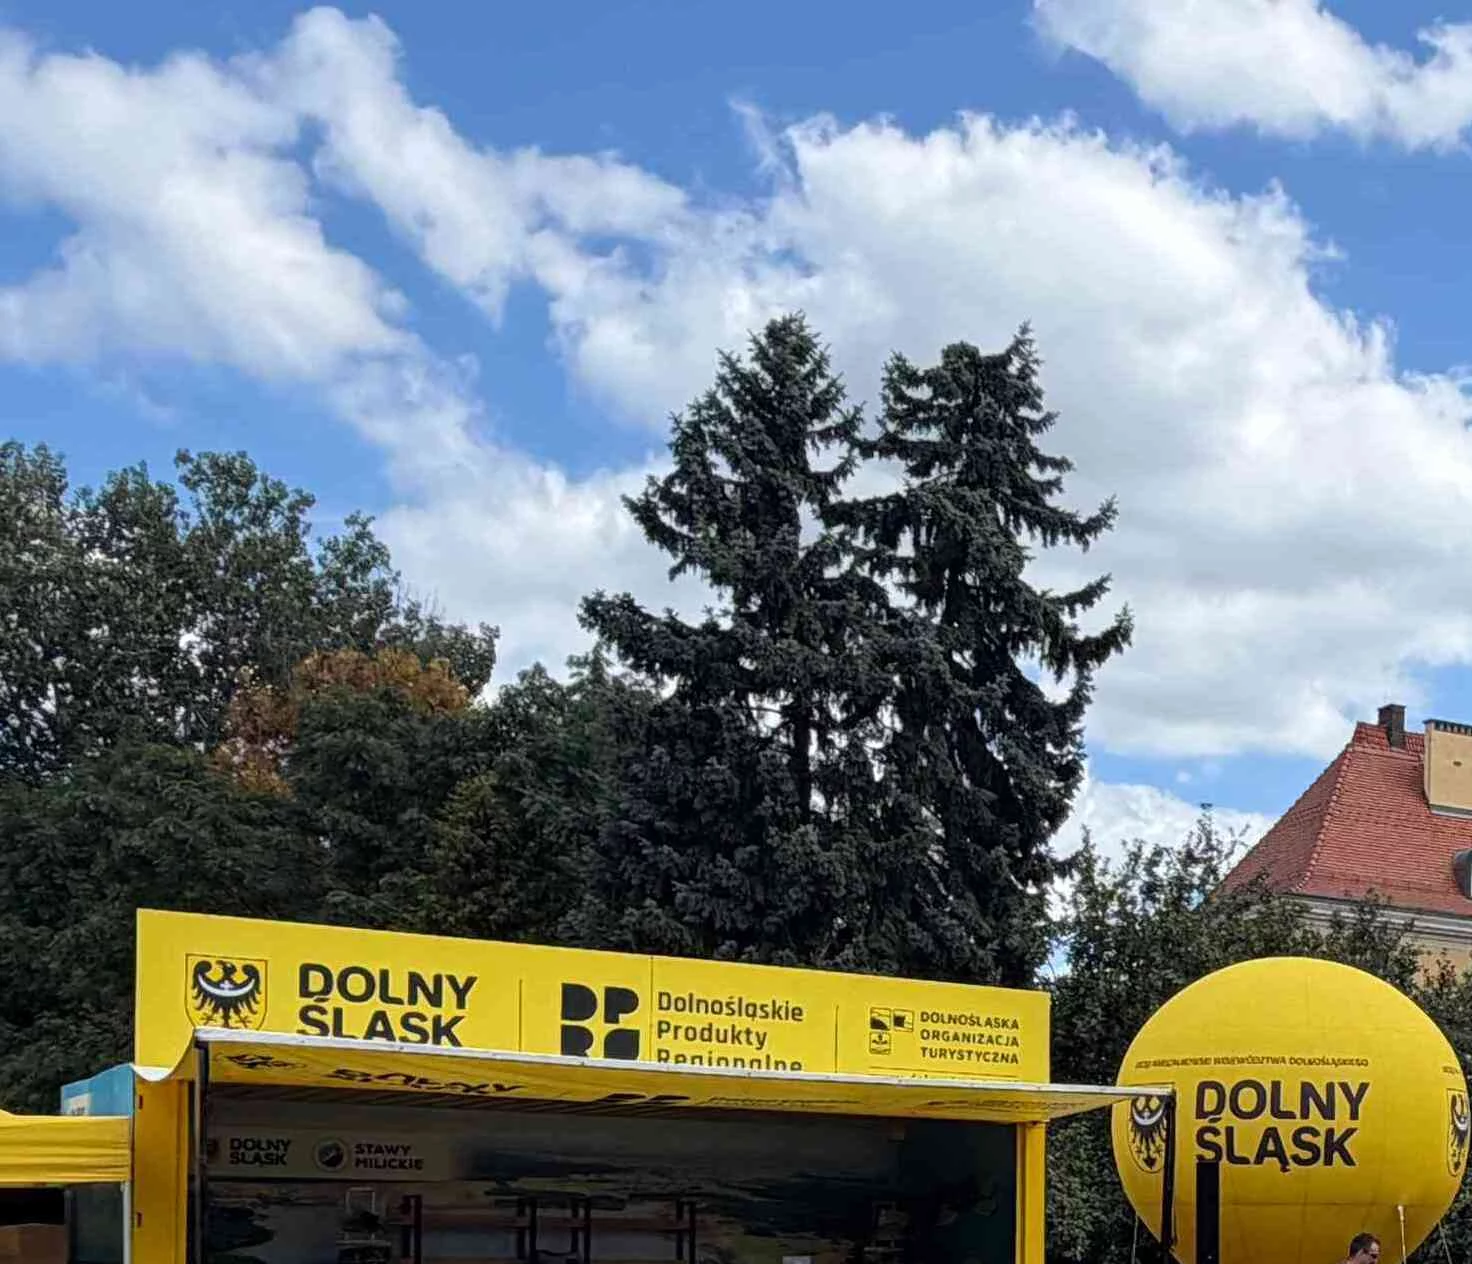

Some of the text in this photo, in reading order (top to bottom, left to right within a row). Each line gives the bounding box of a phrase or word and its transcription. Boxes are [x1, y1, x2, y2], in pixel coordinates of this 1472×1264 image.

[299, 963, 478, 1010] DOLNY
[657, 991, 804, 1023] Dolnośląskie
[920, 1011, 1020, 1030] DOLNOŚLĄSKA
[657, 1020, 768, 1051] Produkty
[920, 1029, 1020, 1048] ORGANIZACJA
[920, 1046, 1020, 1065] TURYSTYCZNA
[1195, 1080, 1371, 1121] DOLNY
[229, 1138, 292, 1152] DOLNY
[354, 1143, 412, 1156] STAWY
[1195, 1117, 1359, 1173] ŚLĄSK
[354, 1157, 425, 1171] MILICKIE
